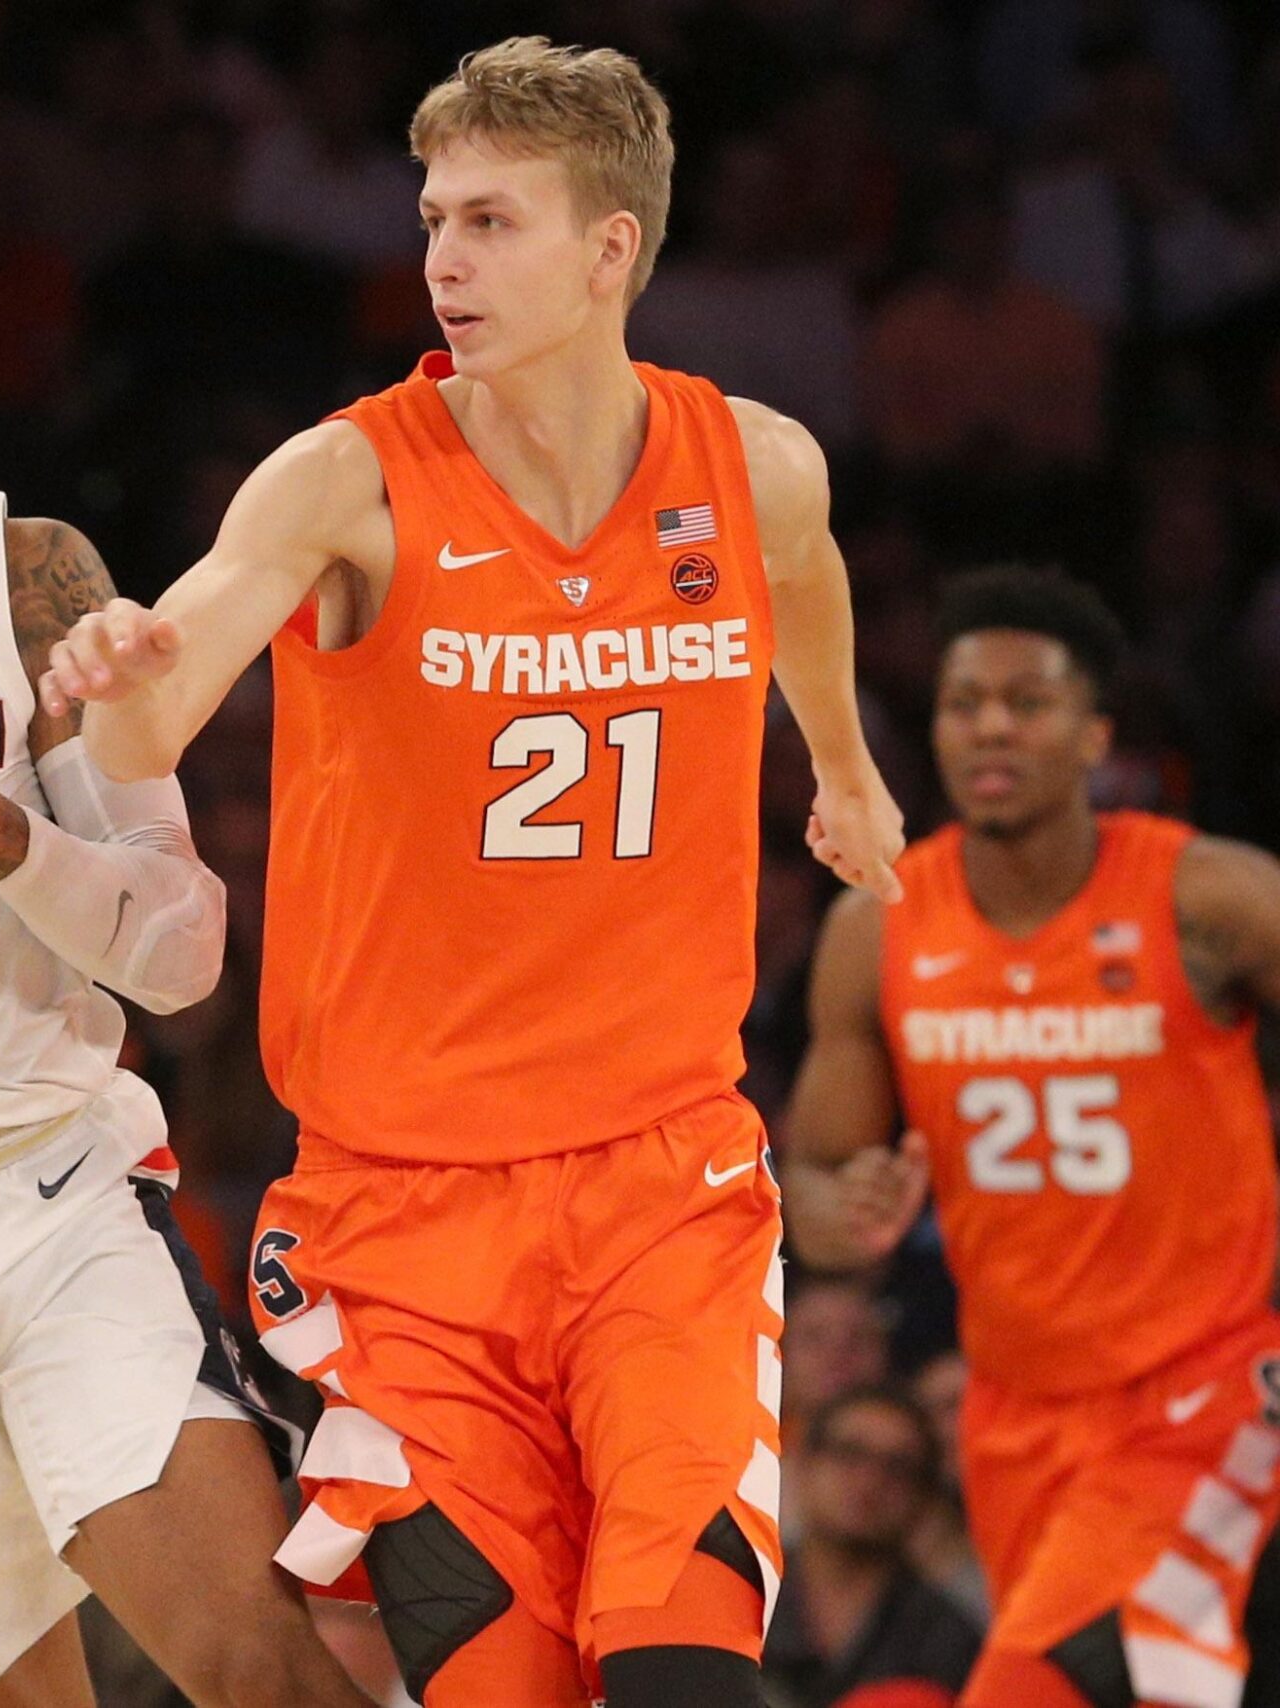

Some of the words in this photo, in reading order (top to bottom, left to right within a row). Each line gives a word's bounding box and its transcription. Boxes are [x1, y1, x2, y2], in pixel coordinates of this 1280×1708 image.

[679, 568, 713, 583] ACC
[420, 618, 752, 695] SYRACUSE
[479, 708, 662, 861] 21
[956, 1073, 1132, 1196] 25
